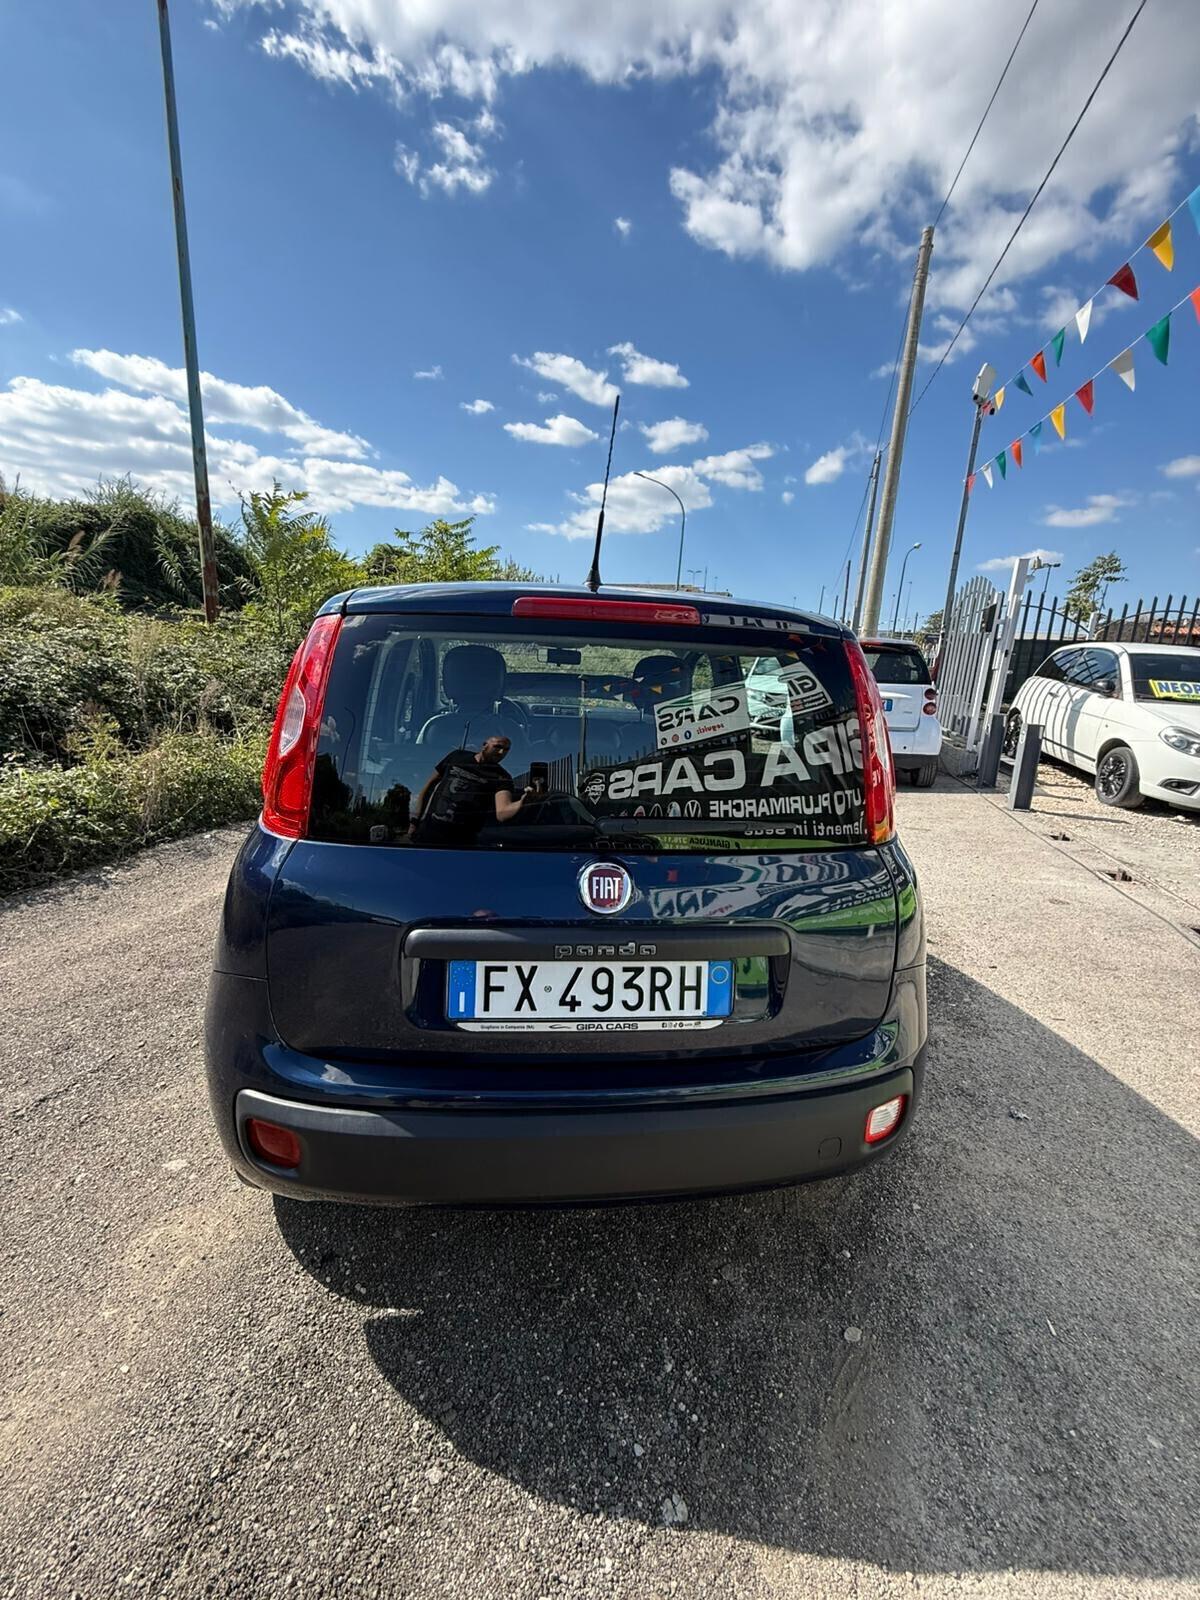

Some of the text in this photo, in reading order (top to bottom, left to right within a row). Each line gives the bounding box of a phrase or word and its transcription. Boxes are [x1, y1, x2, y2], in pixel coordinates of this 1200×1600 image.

[592, 876, 622, 899] FIAT
[555, 941, 657, 959] panda
[576, 1022, 604, 1031] GIPA
[605, 1022, 639, 1030] CARS
